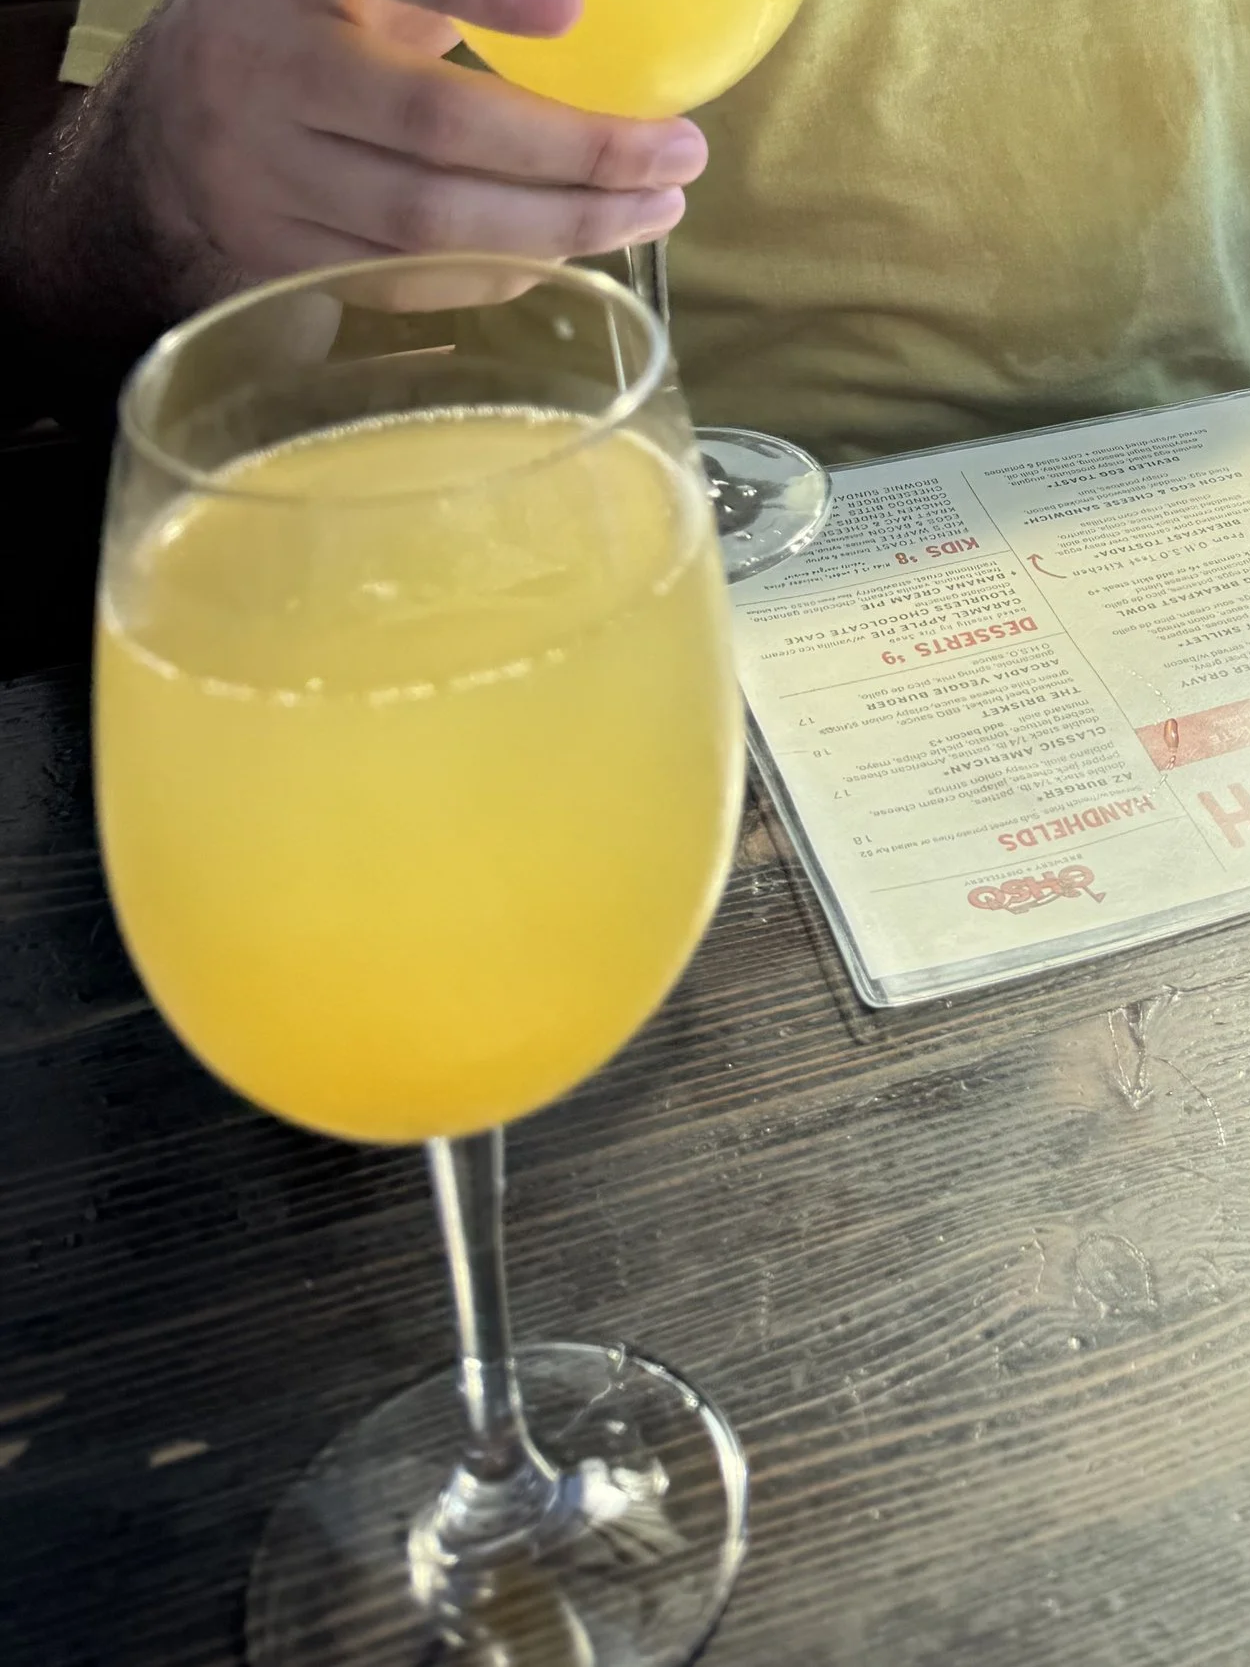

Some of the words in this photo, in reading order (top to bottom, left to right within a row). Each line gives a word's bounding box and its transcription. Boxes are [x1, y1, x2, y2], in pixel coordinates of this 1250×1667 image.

[1127, 456, 1181, 471] DEVILED
[1097, 467, 1125, 477] EGG
[1197, 472, 1244, 486] BACON
[882, 478, 938, 492] BROWNIE
[1169, 482, 1196, 492] EGG
[846, 485, 943, 507] CHEESEBURGER
[886, 492, 947, 508] CORNDOG
[1102, 491, 1154, 507] CHEESE
[847, 504, 884, 515] BITES
[896, 499, 952, 514] CHICKEN
[915, 506, 956, 518] KRAFT
[835, 510, 893, 526] TENDERS
[883, 514, 912, 524] MAC
[925, 513, 960, 524] EGGS
[818, 523, 868, 537] CHEESE
[866, 522, 911, 536] BACON
[878, 527, 929, 542] WAFFLE
[918, 527, 969, 542] FRENCH
[1164, 519, 1242, 541] BREAKFAST
[873, 538, 915, 551] TOAST
[923, 536, 980, 558] KIDS
[892, 550, 917, 565] $8
[944, 572, 1006, 591] BANANA
[888, 587, 941, 604] CREAM
[932, 588, 1016, 612] FLOURLESS
[1158, 580, 1241, 606] BREAKFAST
[859, 599, 885, 610] PIE
[950, 597, 1022, 618] CARAMEL
[1114, 601, 1157, 617] BOWL
[898, 613, 948, 630] APPLE
[783, 630, 824, 645] CAKE
[868, 625, 895, 637] PIE
[912, 616, 1039, 657] DESSERTS
[759, 647, 796, 661] cream
[796, 643, 815, 653] ice
[878, 648, 906, 666] $9
[991, 658, 1061, 680] ARCADIA
[931, 675, 989, 695] VEGGIE
[1176, 668, 1230, 687] GRAVY
[864, 689, 928, 711] BURGER
[1048, 686, 1082, 700] THE
[978, 694, 1047, 718] BRISKET
[1042, 699, 1091, 717] mustard
[797, 716, 815, 726] 17
[1016, 711, 1043, 724] aioli
[981, 720, 1005, 733] add
[927, 736, 943, 747] +3
[943, 726, 981, 743] bacon
[1036, 726, 1107, 750] CLASSIC
[1111, 771, 1135, 783] AZ
[831, 788, 851, 799] 17
[995, 794, 1156, 852] HANDHELDS
[851, 833, 872, 846] 18
